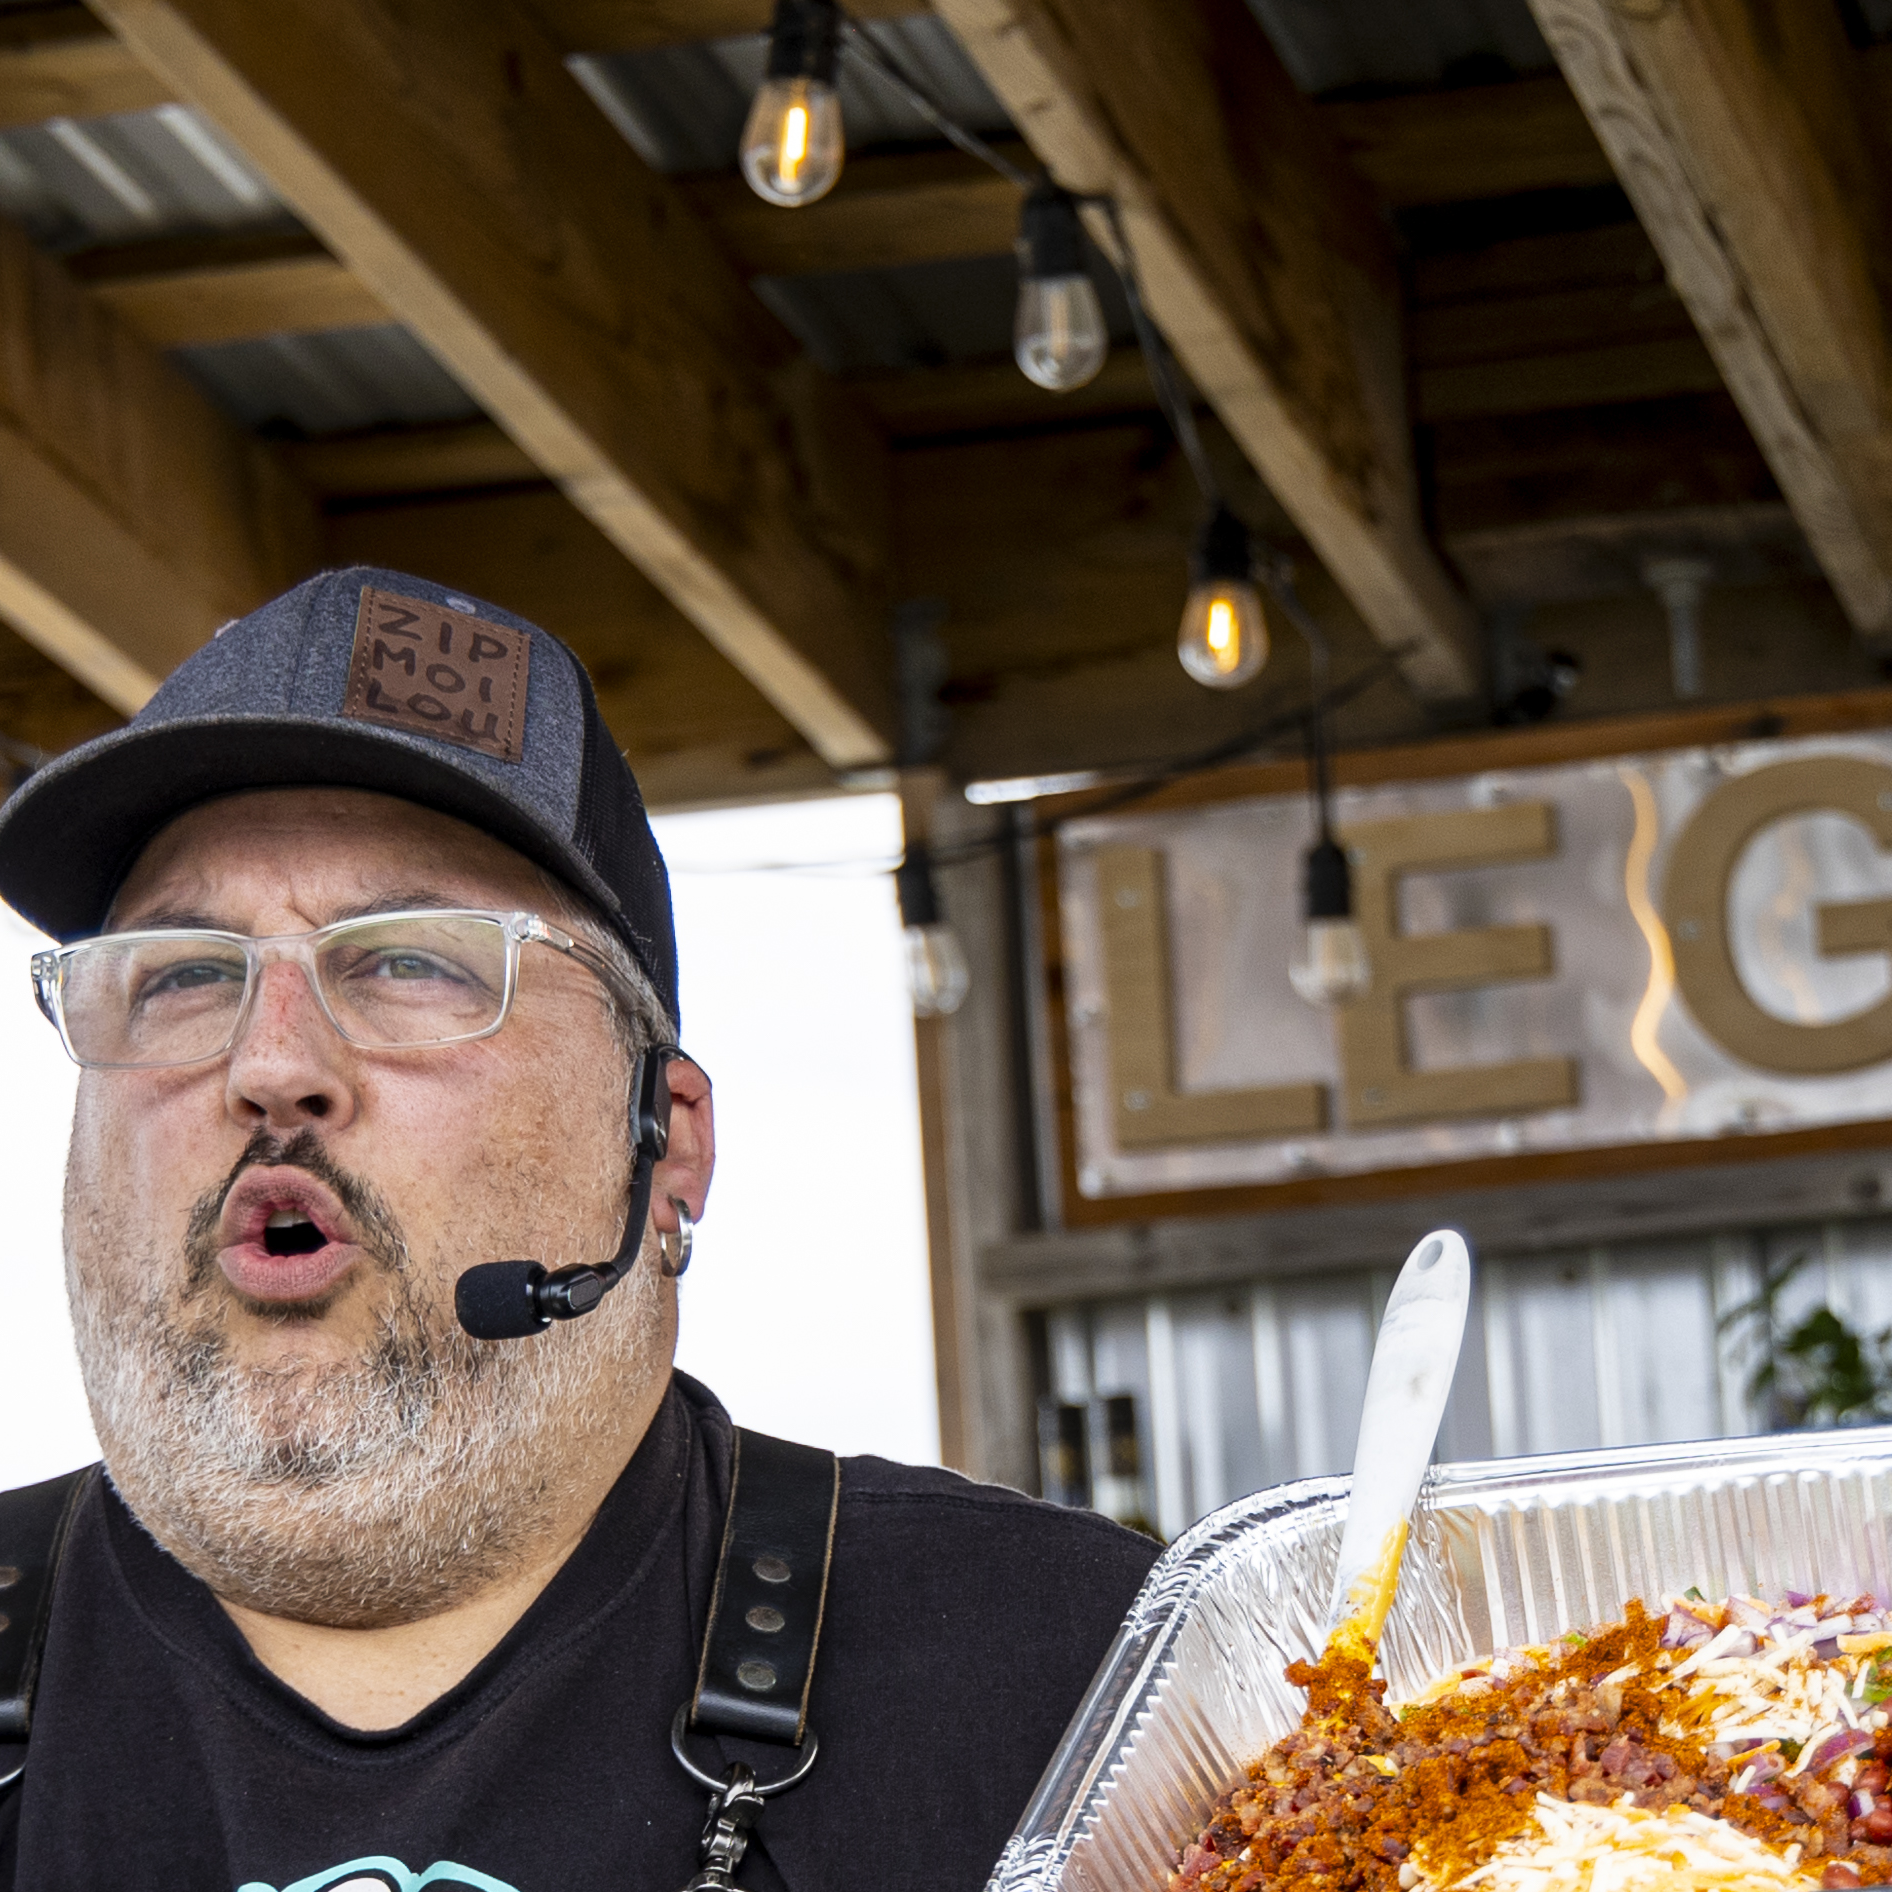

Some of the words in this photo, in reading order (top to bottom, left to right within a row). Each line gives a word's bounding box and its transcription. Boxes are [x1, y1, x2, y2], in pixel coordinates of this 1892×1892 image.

[378, 602, 508, 662] ZIP
[372, 638, 493, 703] MOI
[365, 677, 501, 743] LOU
[1097, 800, 1582, 1157] LE
